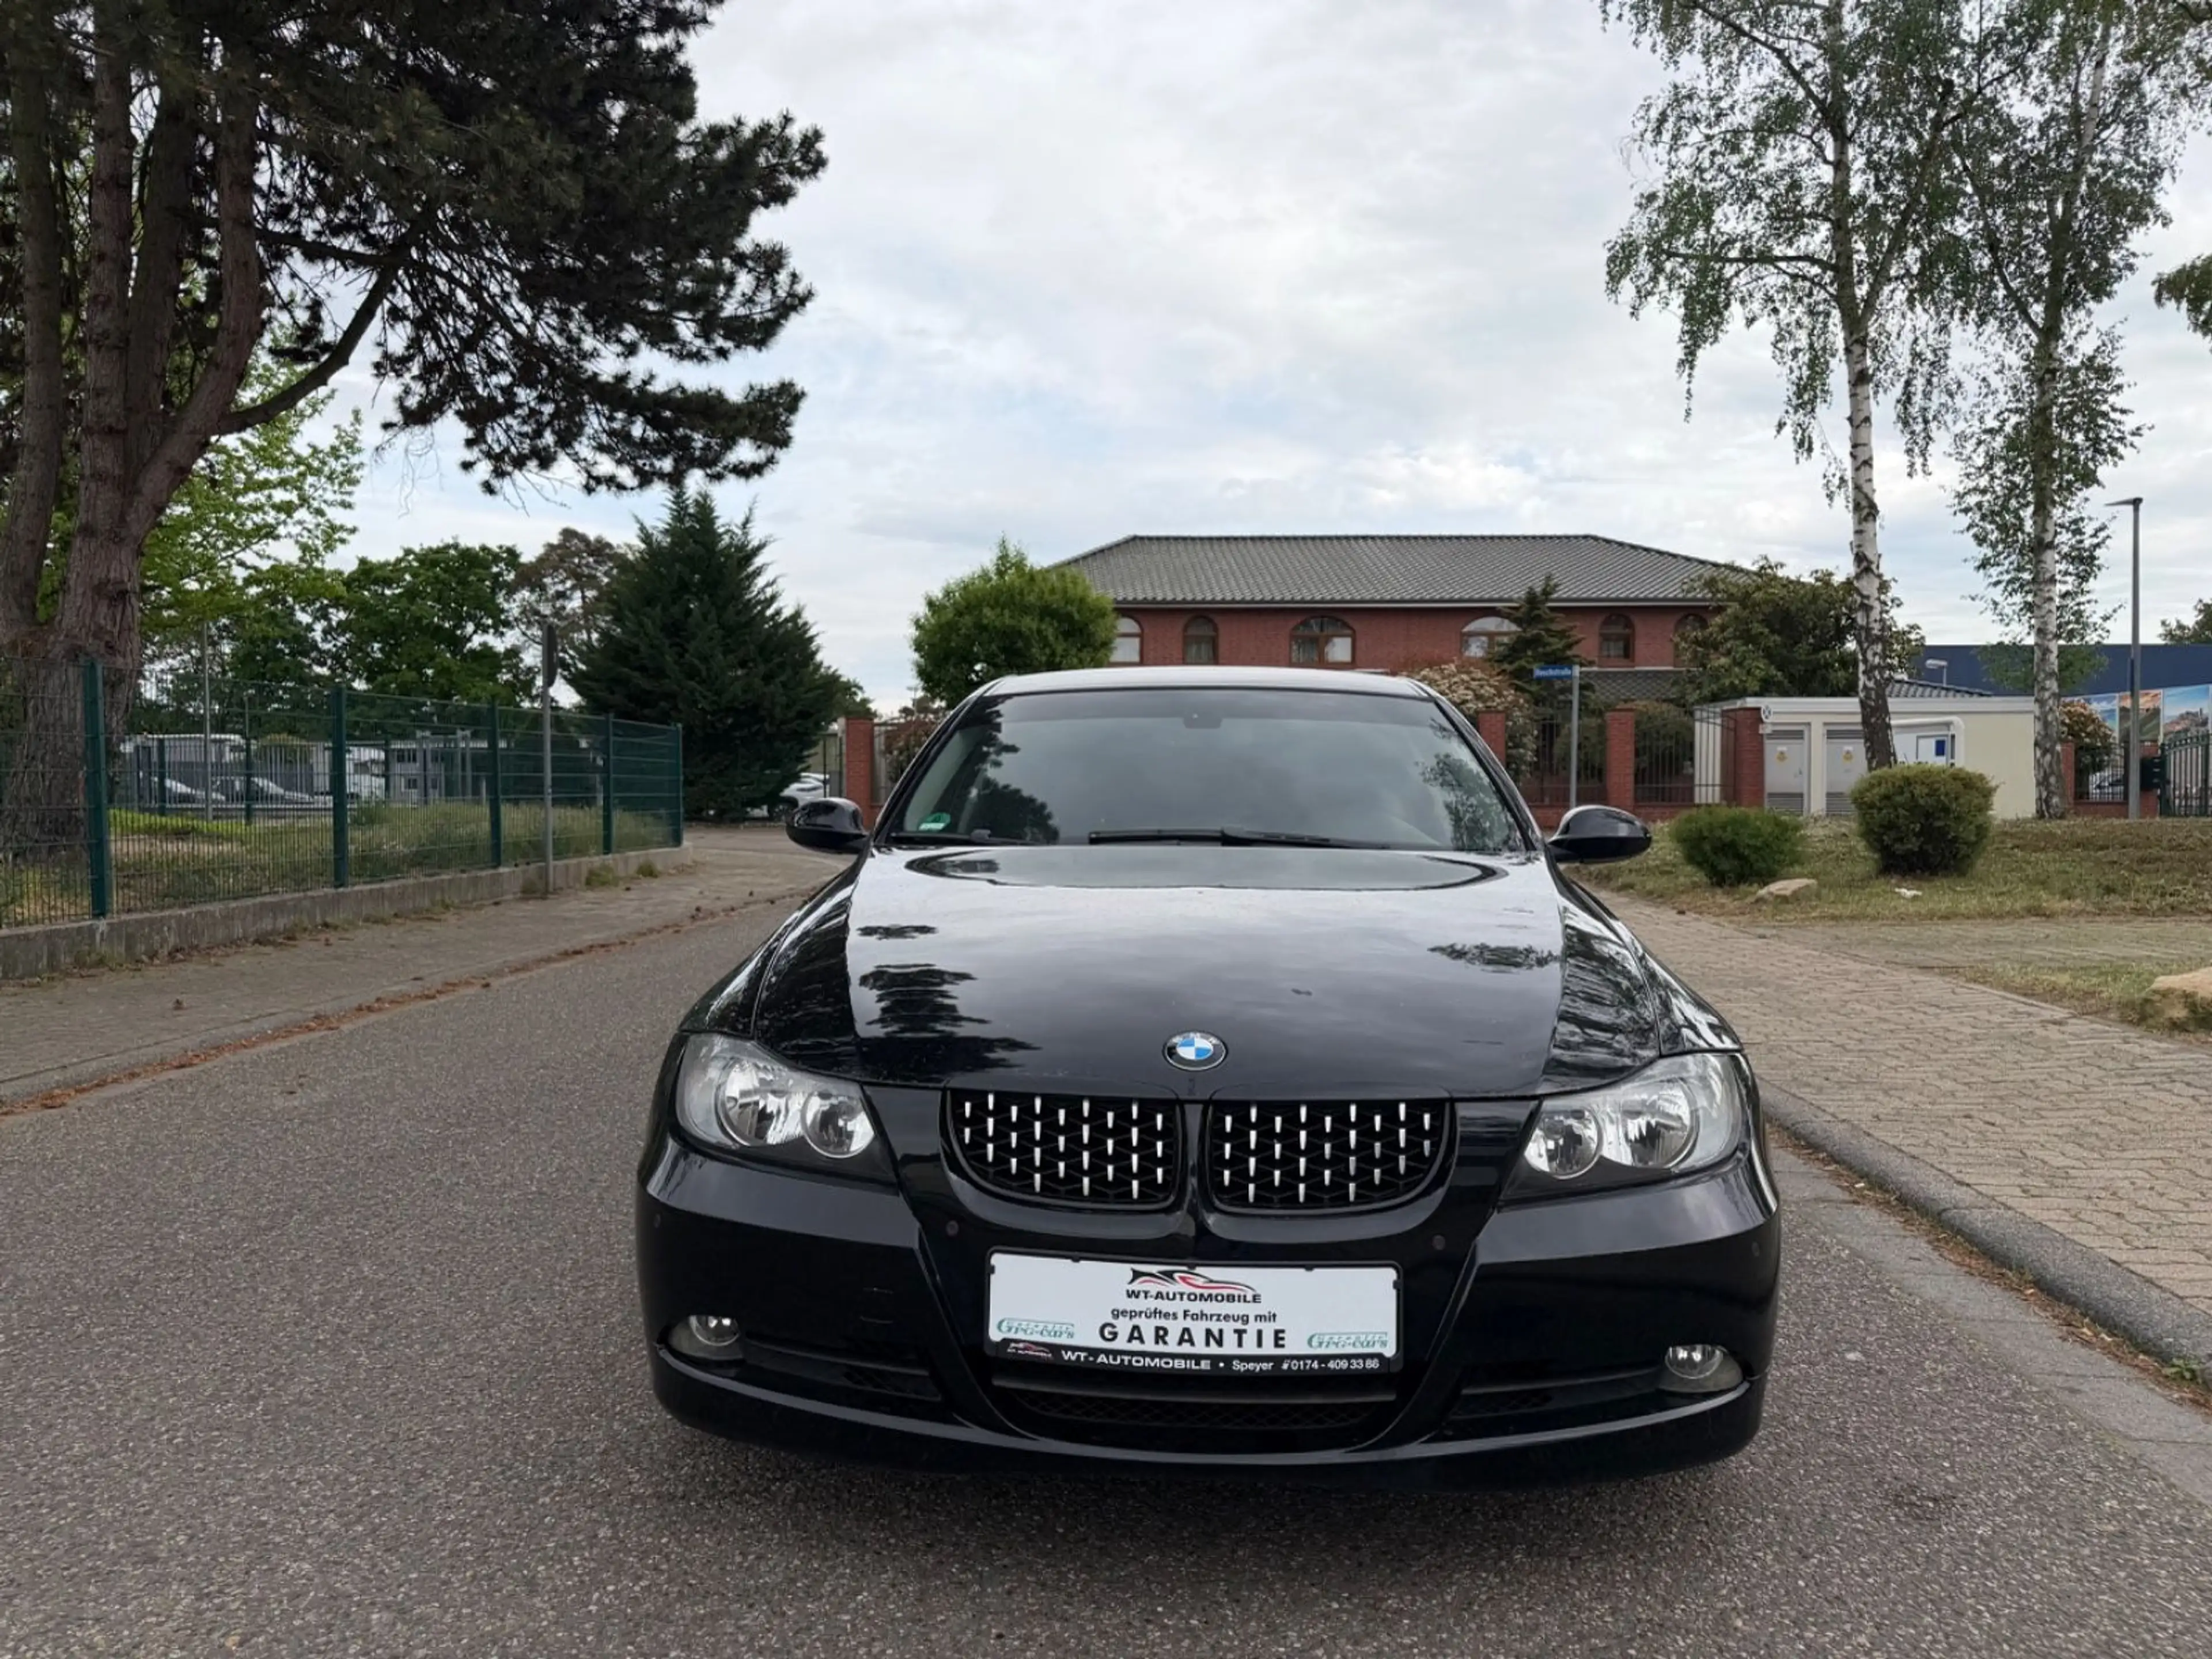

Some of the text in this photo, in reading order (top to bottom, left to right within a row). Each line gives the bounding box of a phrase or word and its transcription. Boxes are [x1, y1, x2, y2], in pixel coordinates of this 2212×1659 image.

[1126, 1289, 1262, 1304] WT-AUTOMOBILE
[1111, 1307, 1277, 1325] geprüftes Fahrzeug mit
[1099, 1322, 1286, 1349] GARANTIE
[1232, 1359, 1274, 1372] Speyer
